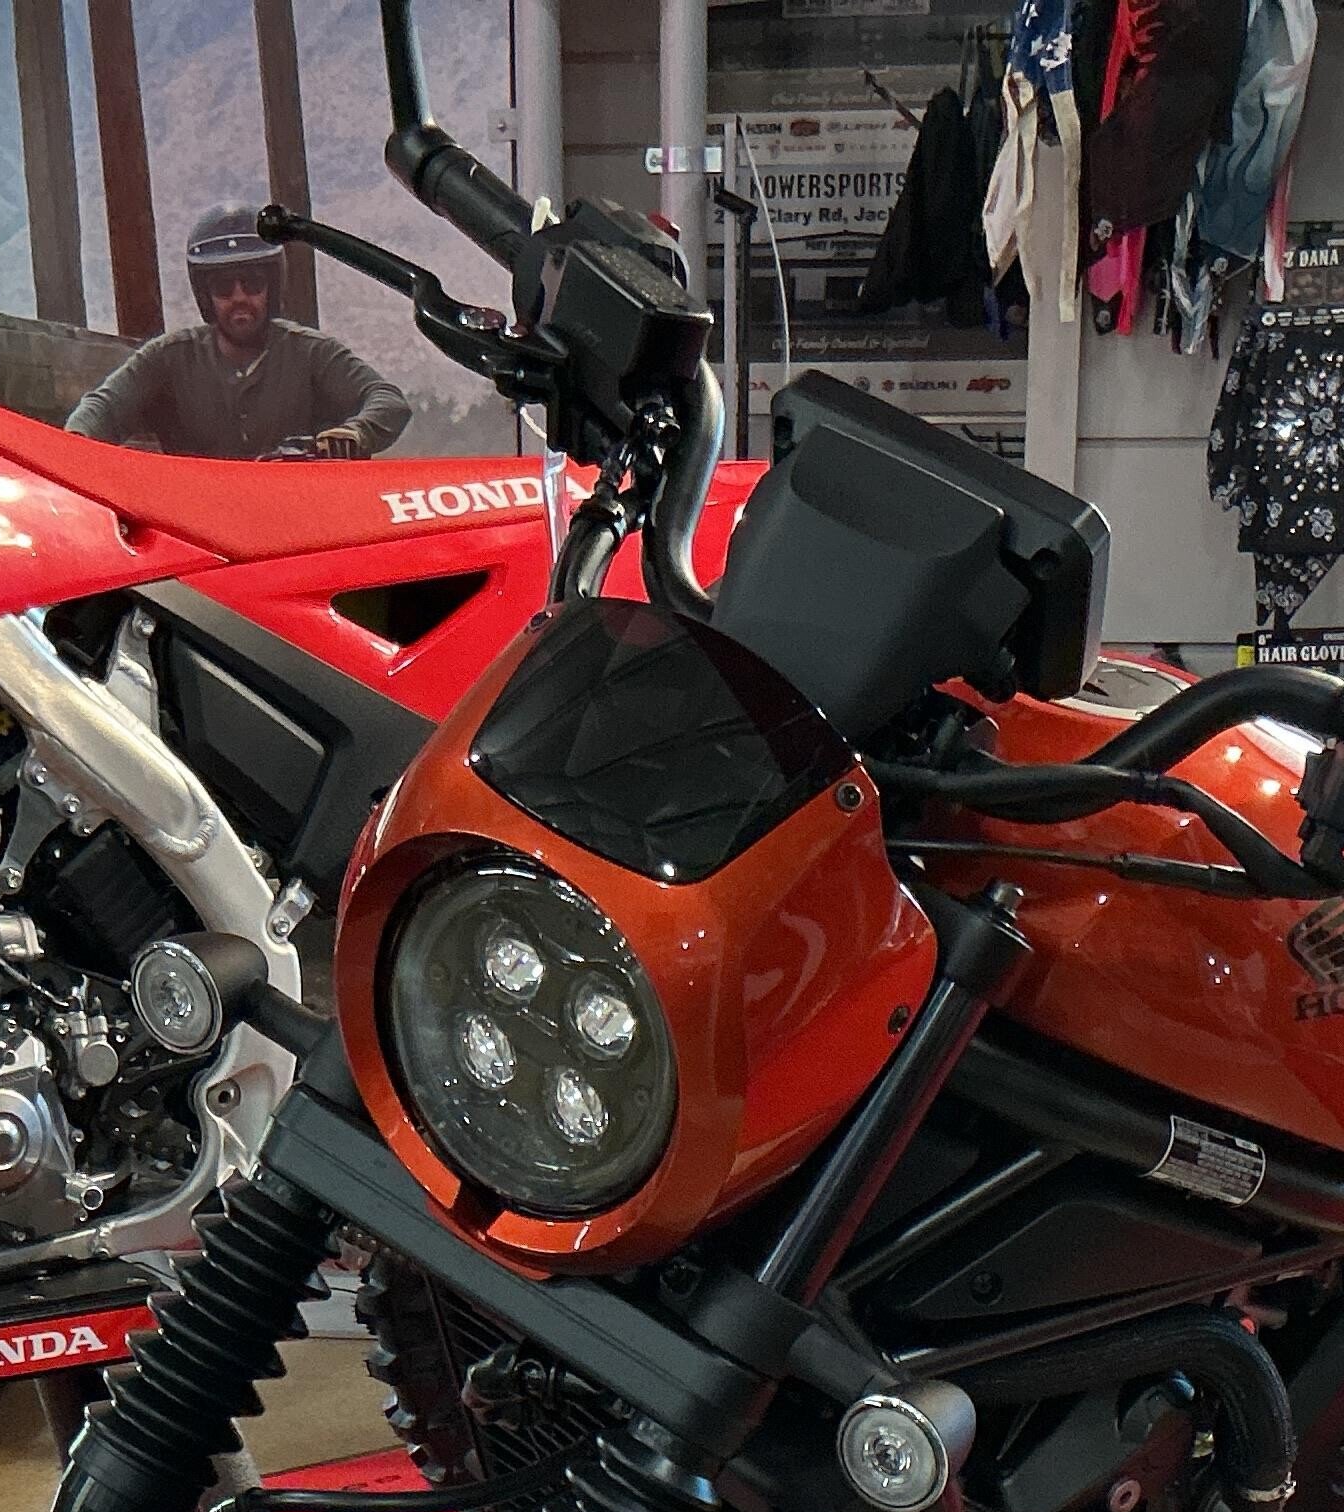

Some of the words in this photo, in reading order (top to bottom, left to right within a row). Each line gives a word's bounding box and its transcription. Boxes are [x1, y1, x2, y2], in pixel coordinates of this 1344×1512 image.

[818, 208, 849, 224] Rd,
[1299, 248, 1339, 267] DANA
[1258, 646, 1297, 663] HAIR
